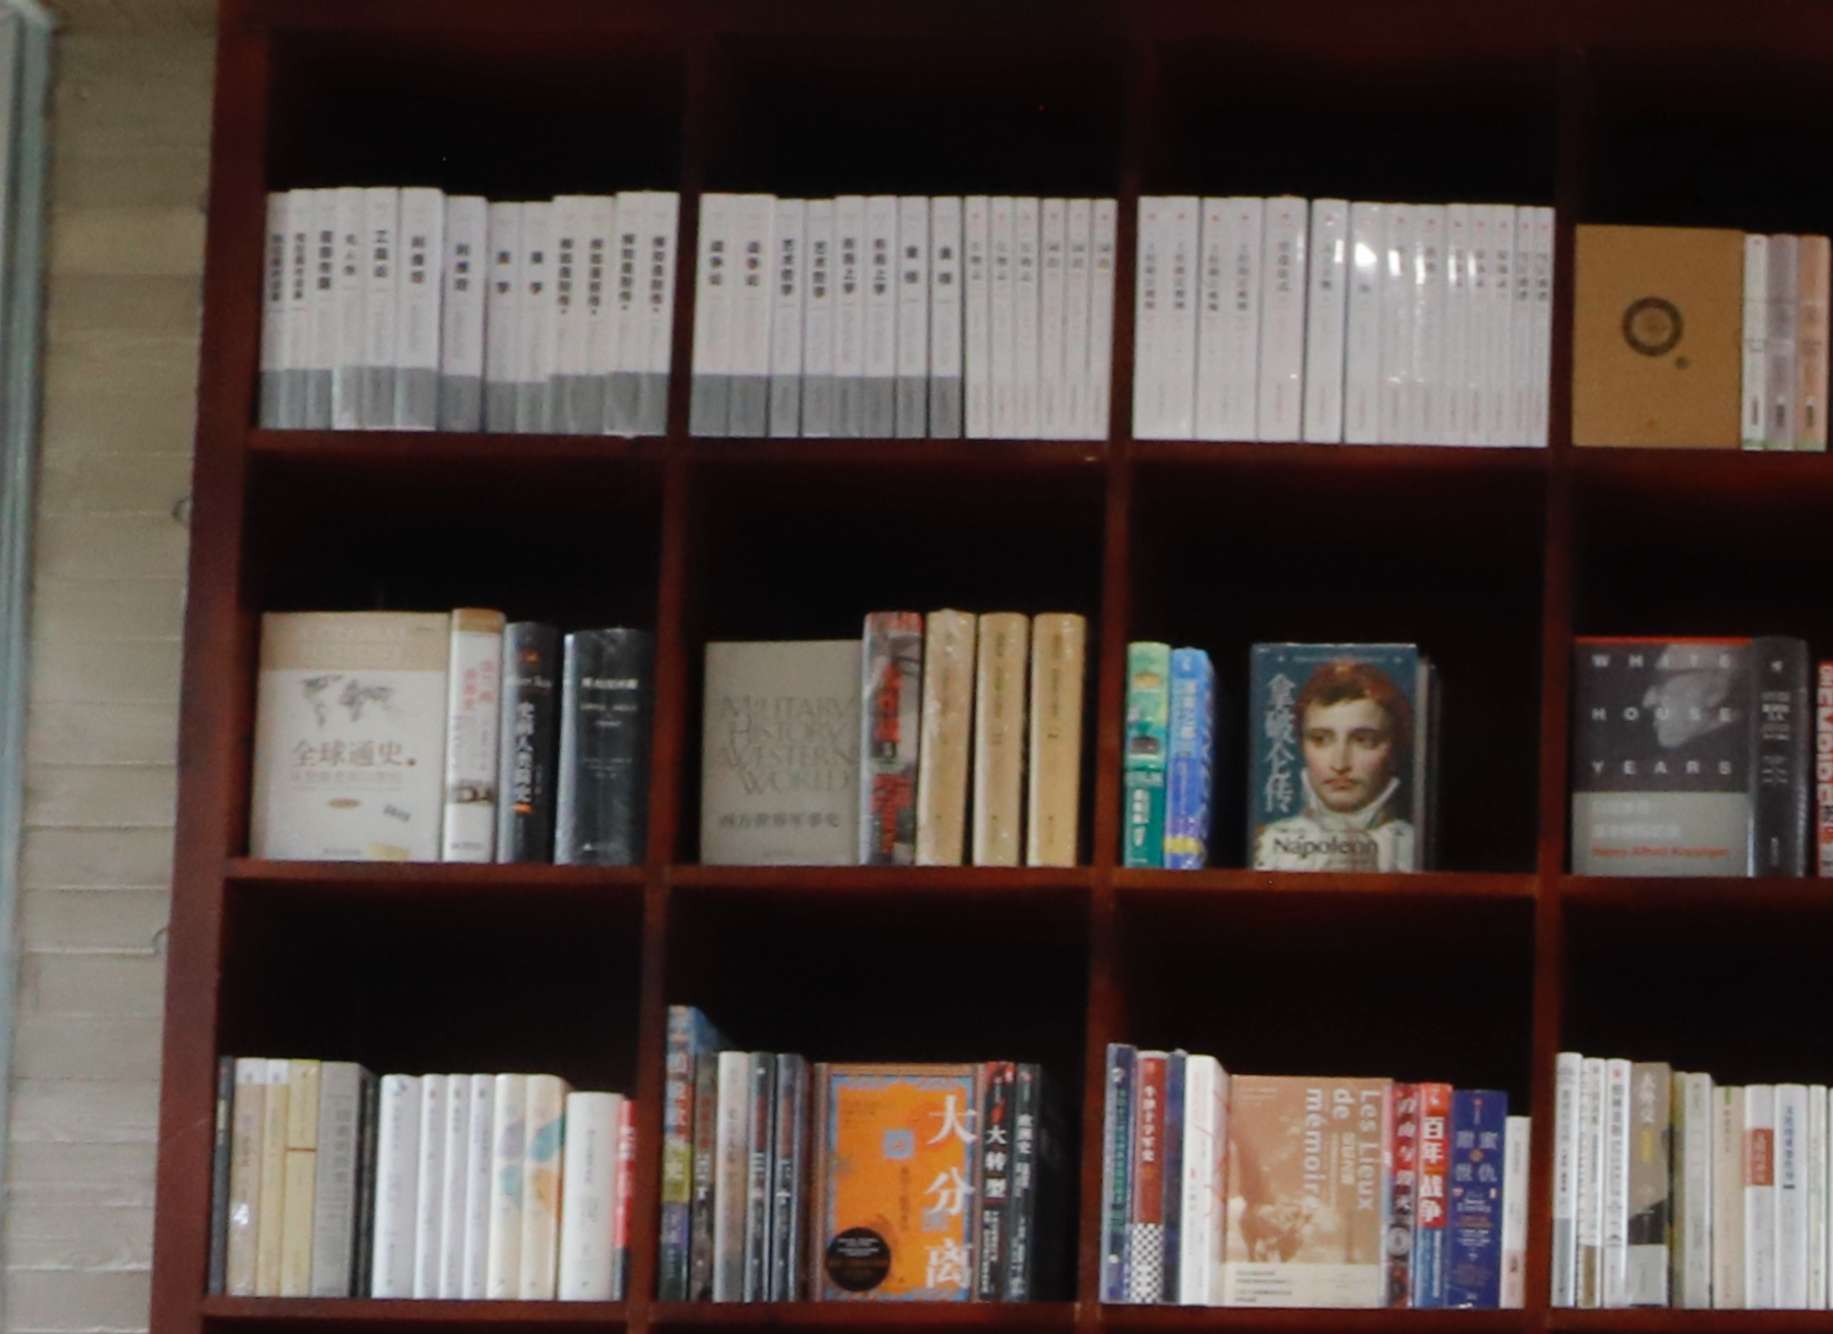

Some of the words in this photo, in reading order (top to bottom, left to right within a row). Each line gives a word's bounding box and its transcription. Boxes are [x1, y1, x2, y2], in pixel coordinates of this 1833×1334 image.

[1592, 655, 1732, 668] WHITE
[1592, 708, 1732, 722] HOUSE
[294, 739, 405, 769] 全球通史
[1592, 761, 1732, 775] YEARS
[1332, 1087, 1350, 1120] de
[1358, 1087, 1383, 1134] Les
[1356, 1139, 1383, 1211] Lieux
[1420, 1116, 1446, 1224] 百年战争
[925, 1095, 979, 1292] 大分离
